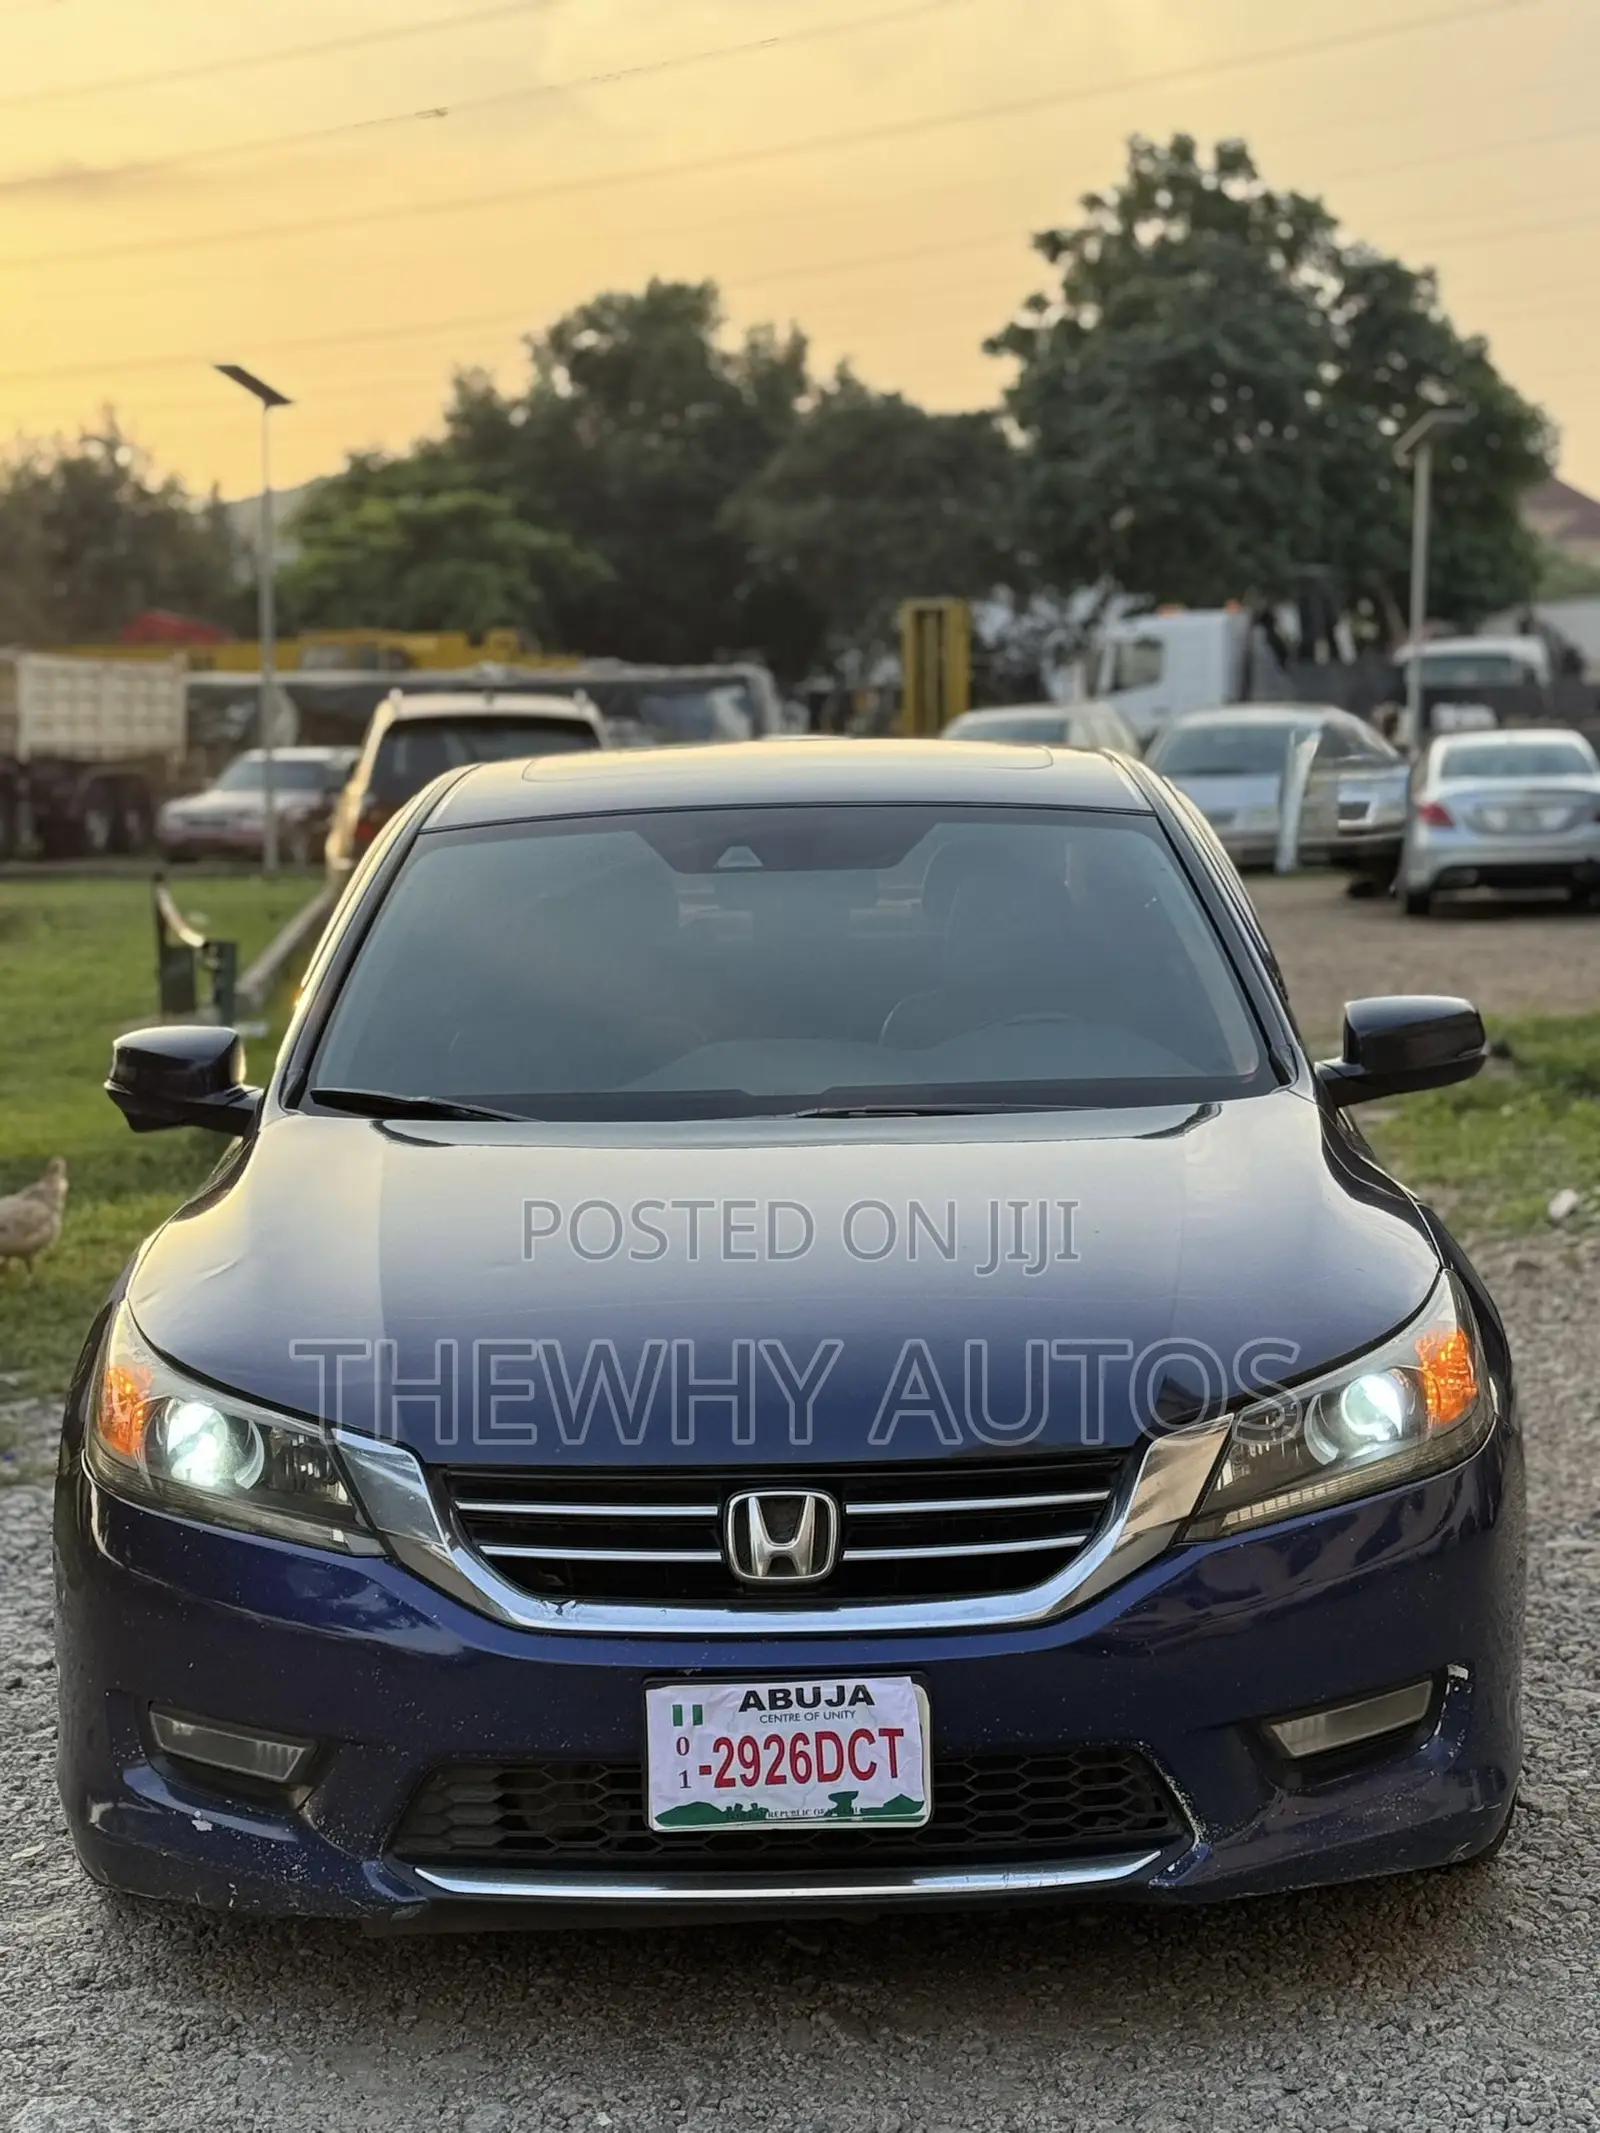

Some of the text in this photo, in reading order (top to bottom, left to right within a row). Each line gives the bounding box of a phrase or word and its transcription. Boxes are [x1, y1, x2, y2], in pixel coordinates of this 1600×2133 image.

[738, 1684, 875, 1713] ABUJA
[759, 1709, 857, 1724] CENTRE OF UNITY
[768, 1808, 811, 1818] REPUBLIC
